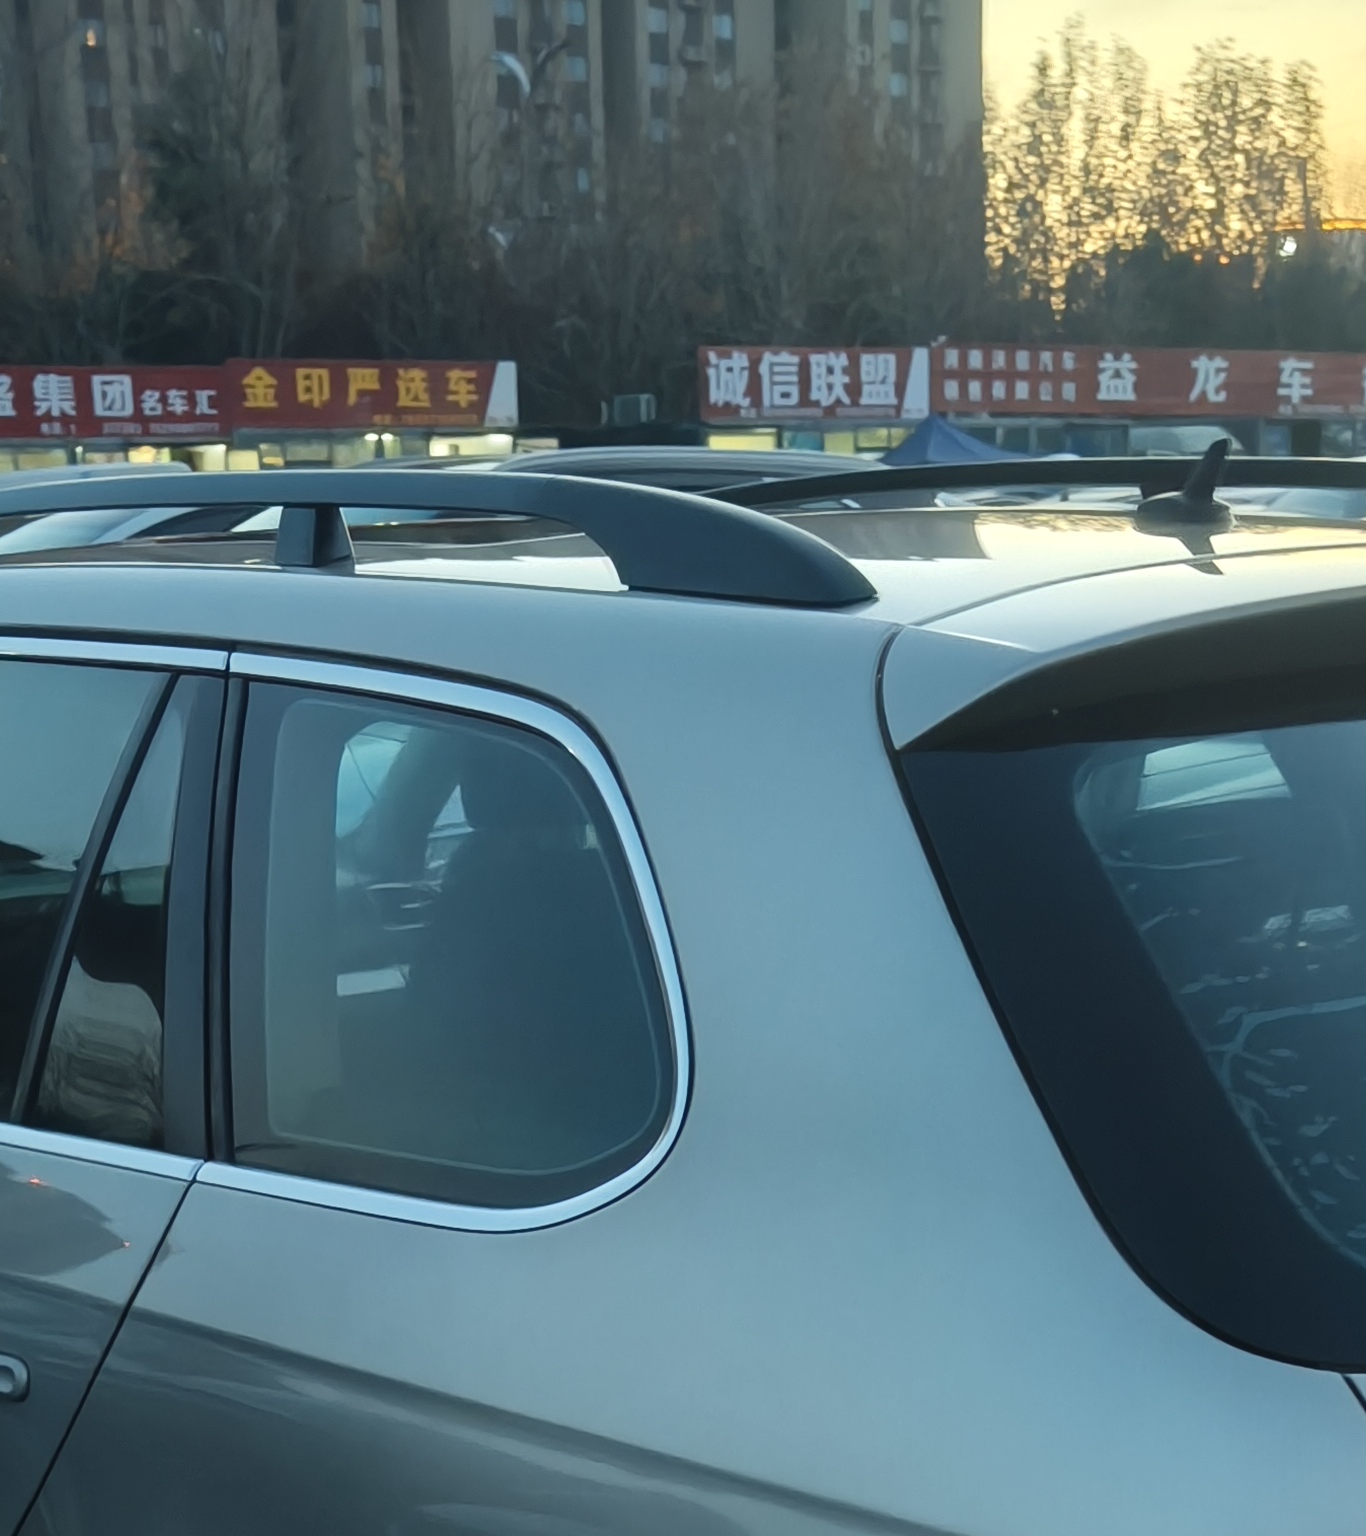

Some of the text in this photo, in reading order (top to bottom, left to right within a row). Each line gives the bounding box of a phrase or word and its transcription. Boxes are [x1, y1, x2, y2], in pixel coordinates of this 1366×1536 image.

[241, 366, 480, 409] 金印严选车
[705, 349, 898, 408] 诚信联盟
[140, 389, 219, 416] 名车汇
